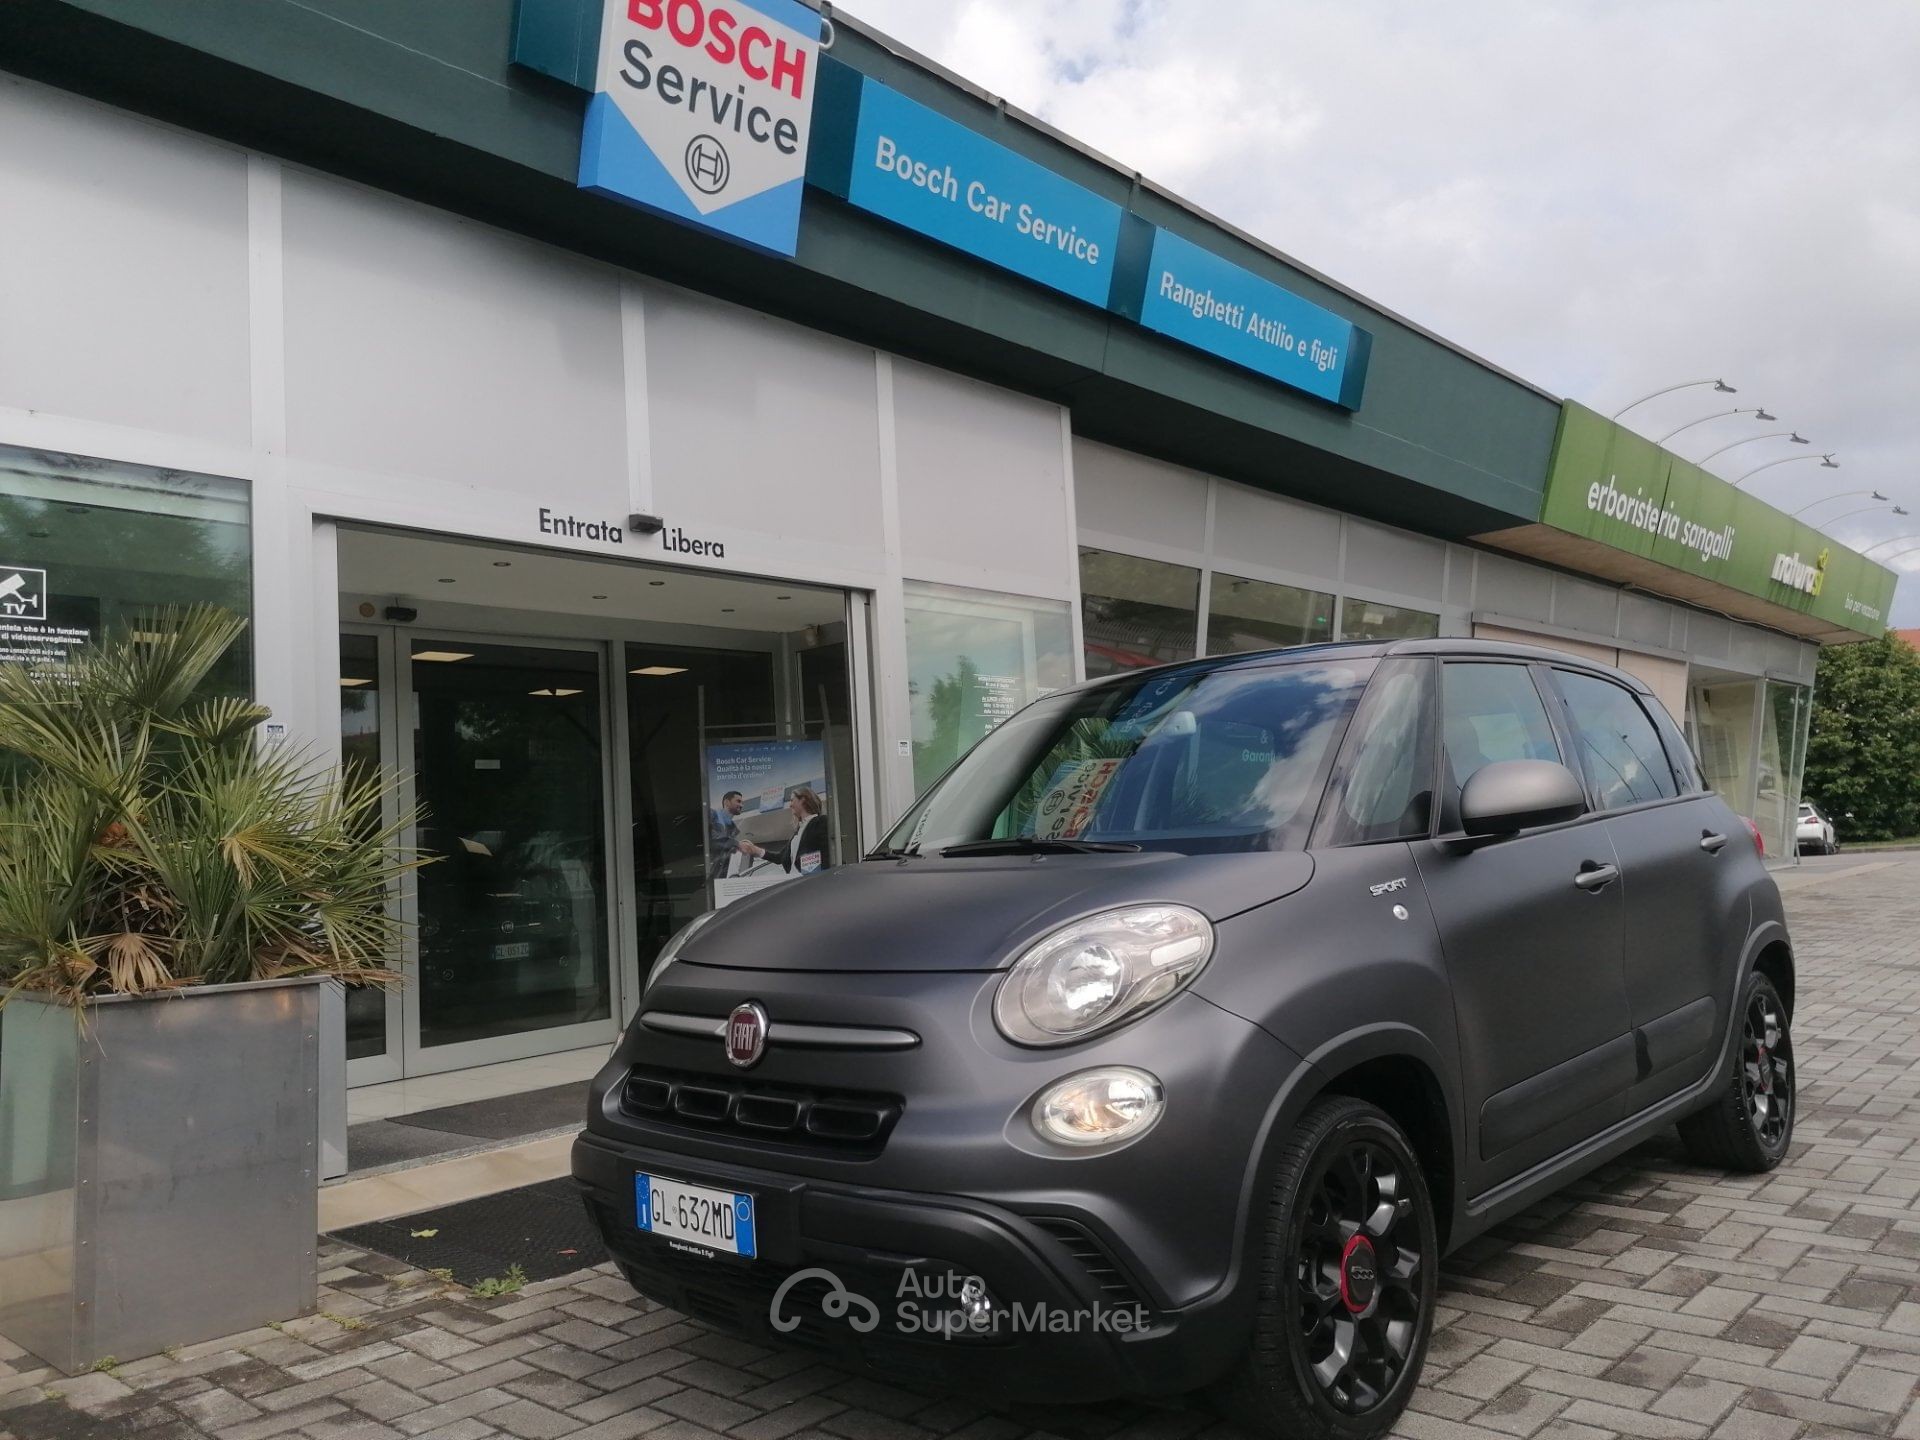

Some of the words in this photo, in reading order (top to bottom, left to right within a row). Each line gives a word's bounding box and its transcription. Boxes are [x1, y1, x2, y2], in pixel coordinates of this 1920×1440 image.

[619, 39, 798, 155] Service
[875, 135, 958, 202] Bosch
[967, 181, 1011, 224] Car
[1016, 203, 1100, 265] Service
[1160, 271, 1245, 330] Ranghetti
[1246, 312, 1294, 352] Attilio
[1297, 340, 1307, 357] e
[1310, 339, 1338, 372] figli
[539, 507, 623, 544] Entrata
[662, 527, 725, 558] Libera
[1587, 474, 1681, 541] erboristeria
[1680, 520, 1736, 562] sangalli
[3, 602, 26, 615] TV
[23, 625, 39, 633] che
[47, 626, 56, 634] in
[57, 627, 89, 636] funzione
[1369, 877, 1407, 897] SPORT
[732, 1022, 757, 1051] FIAT
[651, 1188, 672, 1227] GL
[678, 1194, 735, 1240] 632MD
